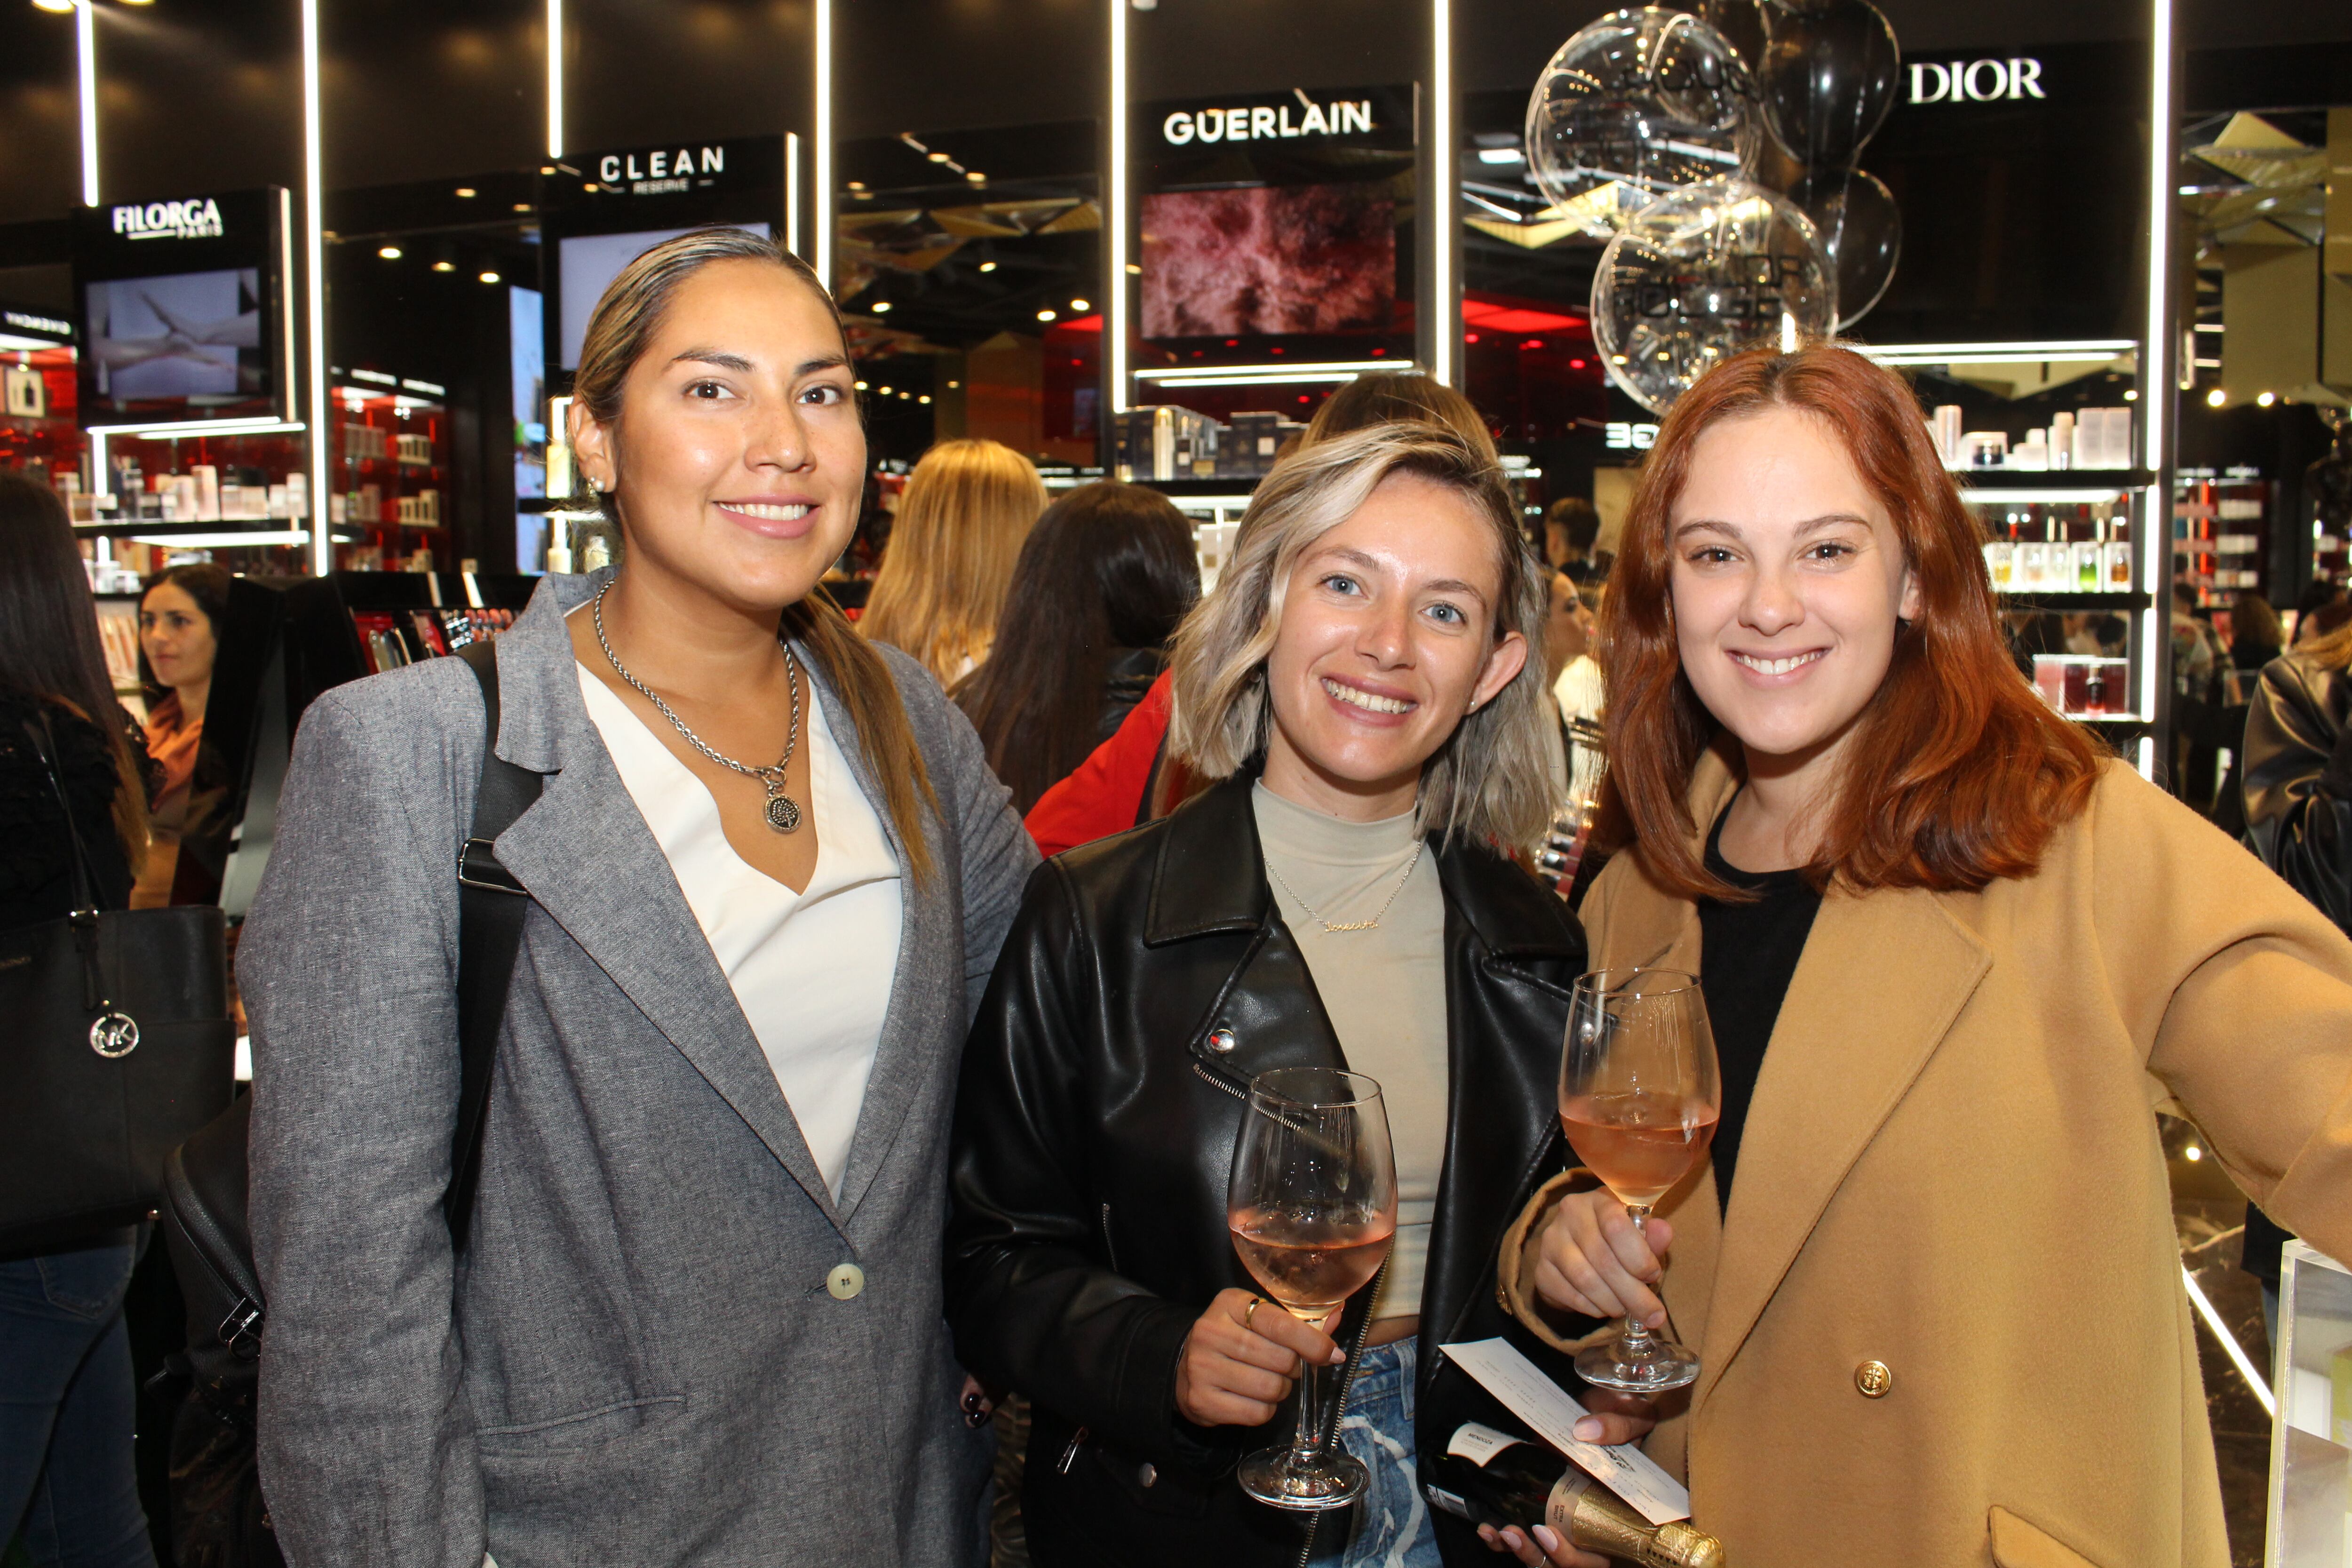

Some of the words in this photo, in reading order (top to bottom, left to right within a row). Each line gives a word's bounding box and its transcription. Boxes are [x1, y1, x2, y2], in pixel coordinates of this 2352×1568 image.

[1907, 58, 2046, 104] DIOR
[1164, 100, 1371, 145] GUERLAIN
[601, 146, 723, 182] CLEAN
[633, 178, 689, 195] RESERVE
[113, 198, 222, 233] FILORGA
[176, 223, 223, 239] PARIS
[1468, 1433, 1494, 1445] MENDOZA
